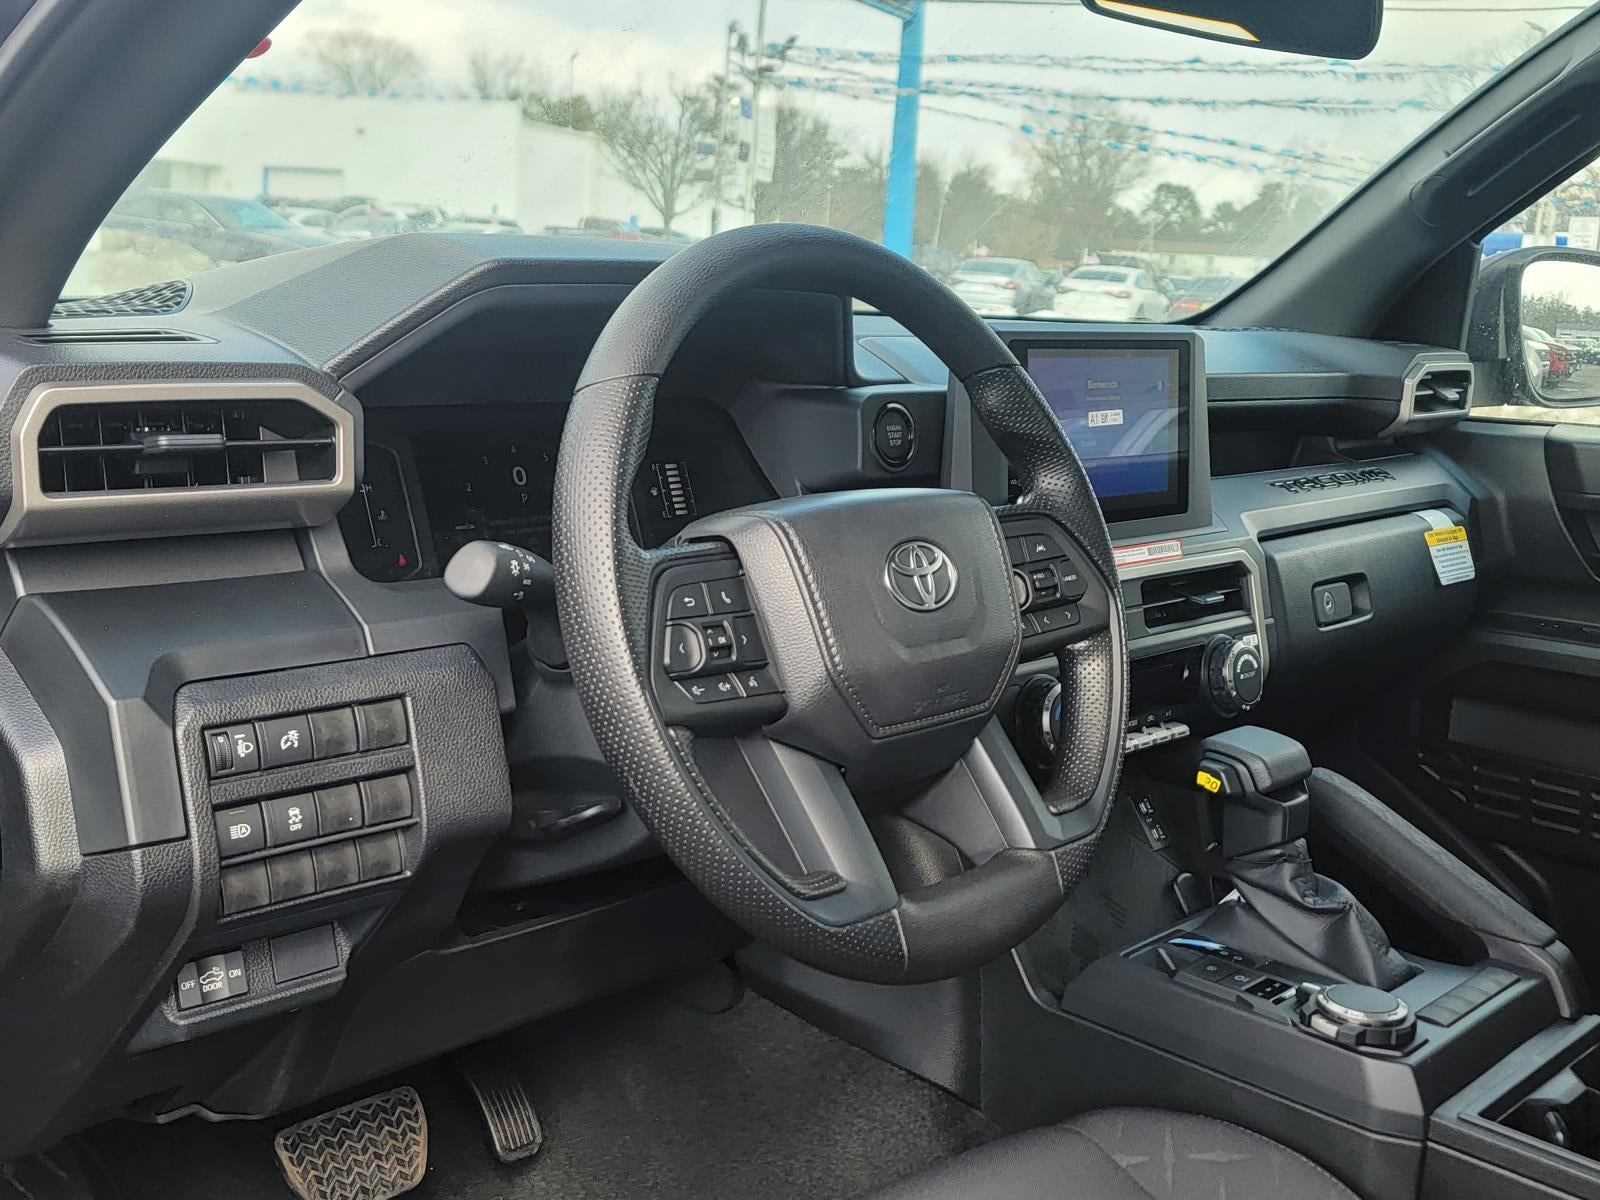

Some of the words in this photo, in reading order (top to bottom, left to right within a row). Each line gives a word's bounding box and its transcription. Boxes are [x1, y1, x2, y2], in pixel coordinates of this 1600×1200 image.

[887, 431, 902, 439] START
[889, 439, 902, 447] STOP
[512, 466, 527, 486] 0
[1268, 466, 1396, 494] TACOMA
[520, 493, 528, 504] P
[289, 823, 303, 831] OFF
[229, 969, 242, 978] ON
[181, 980, 196, 990] OFF
[202, 981, 223, 993] DOOR
